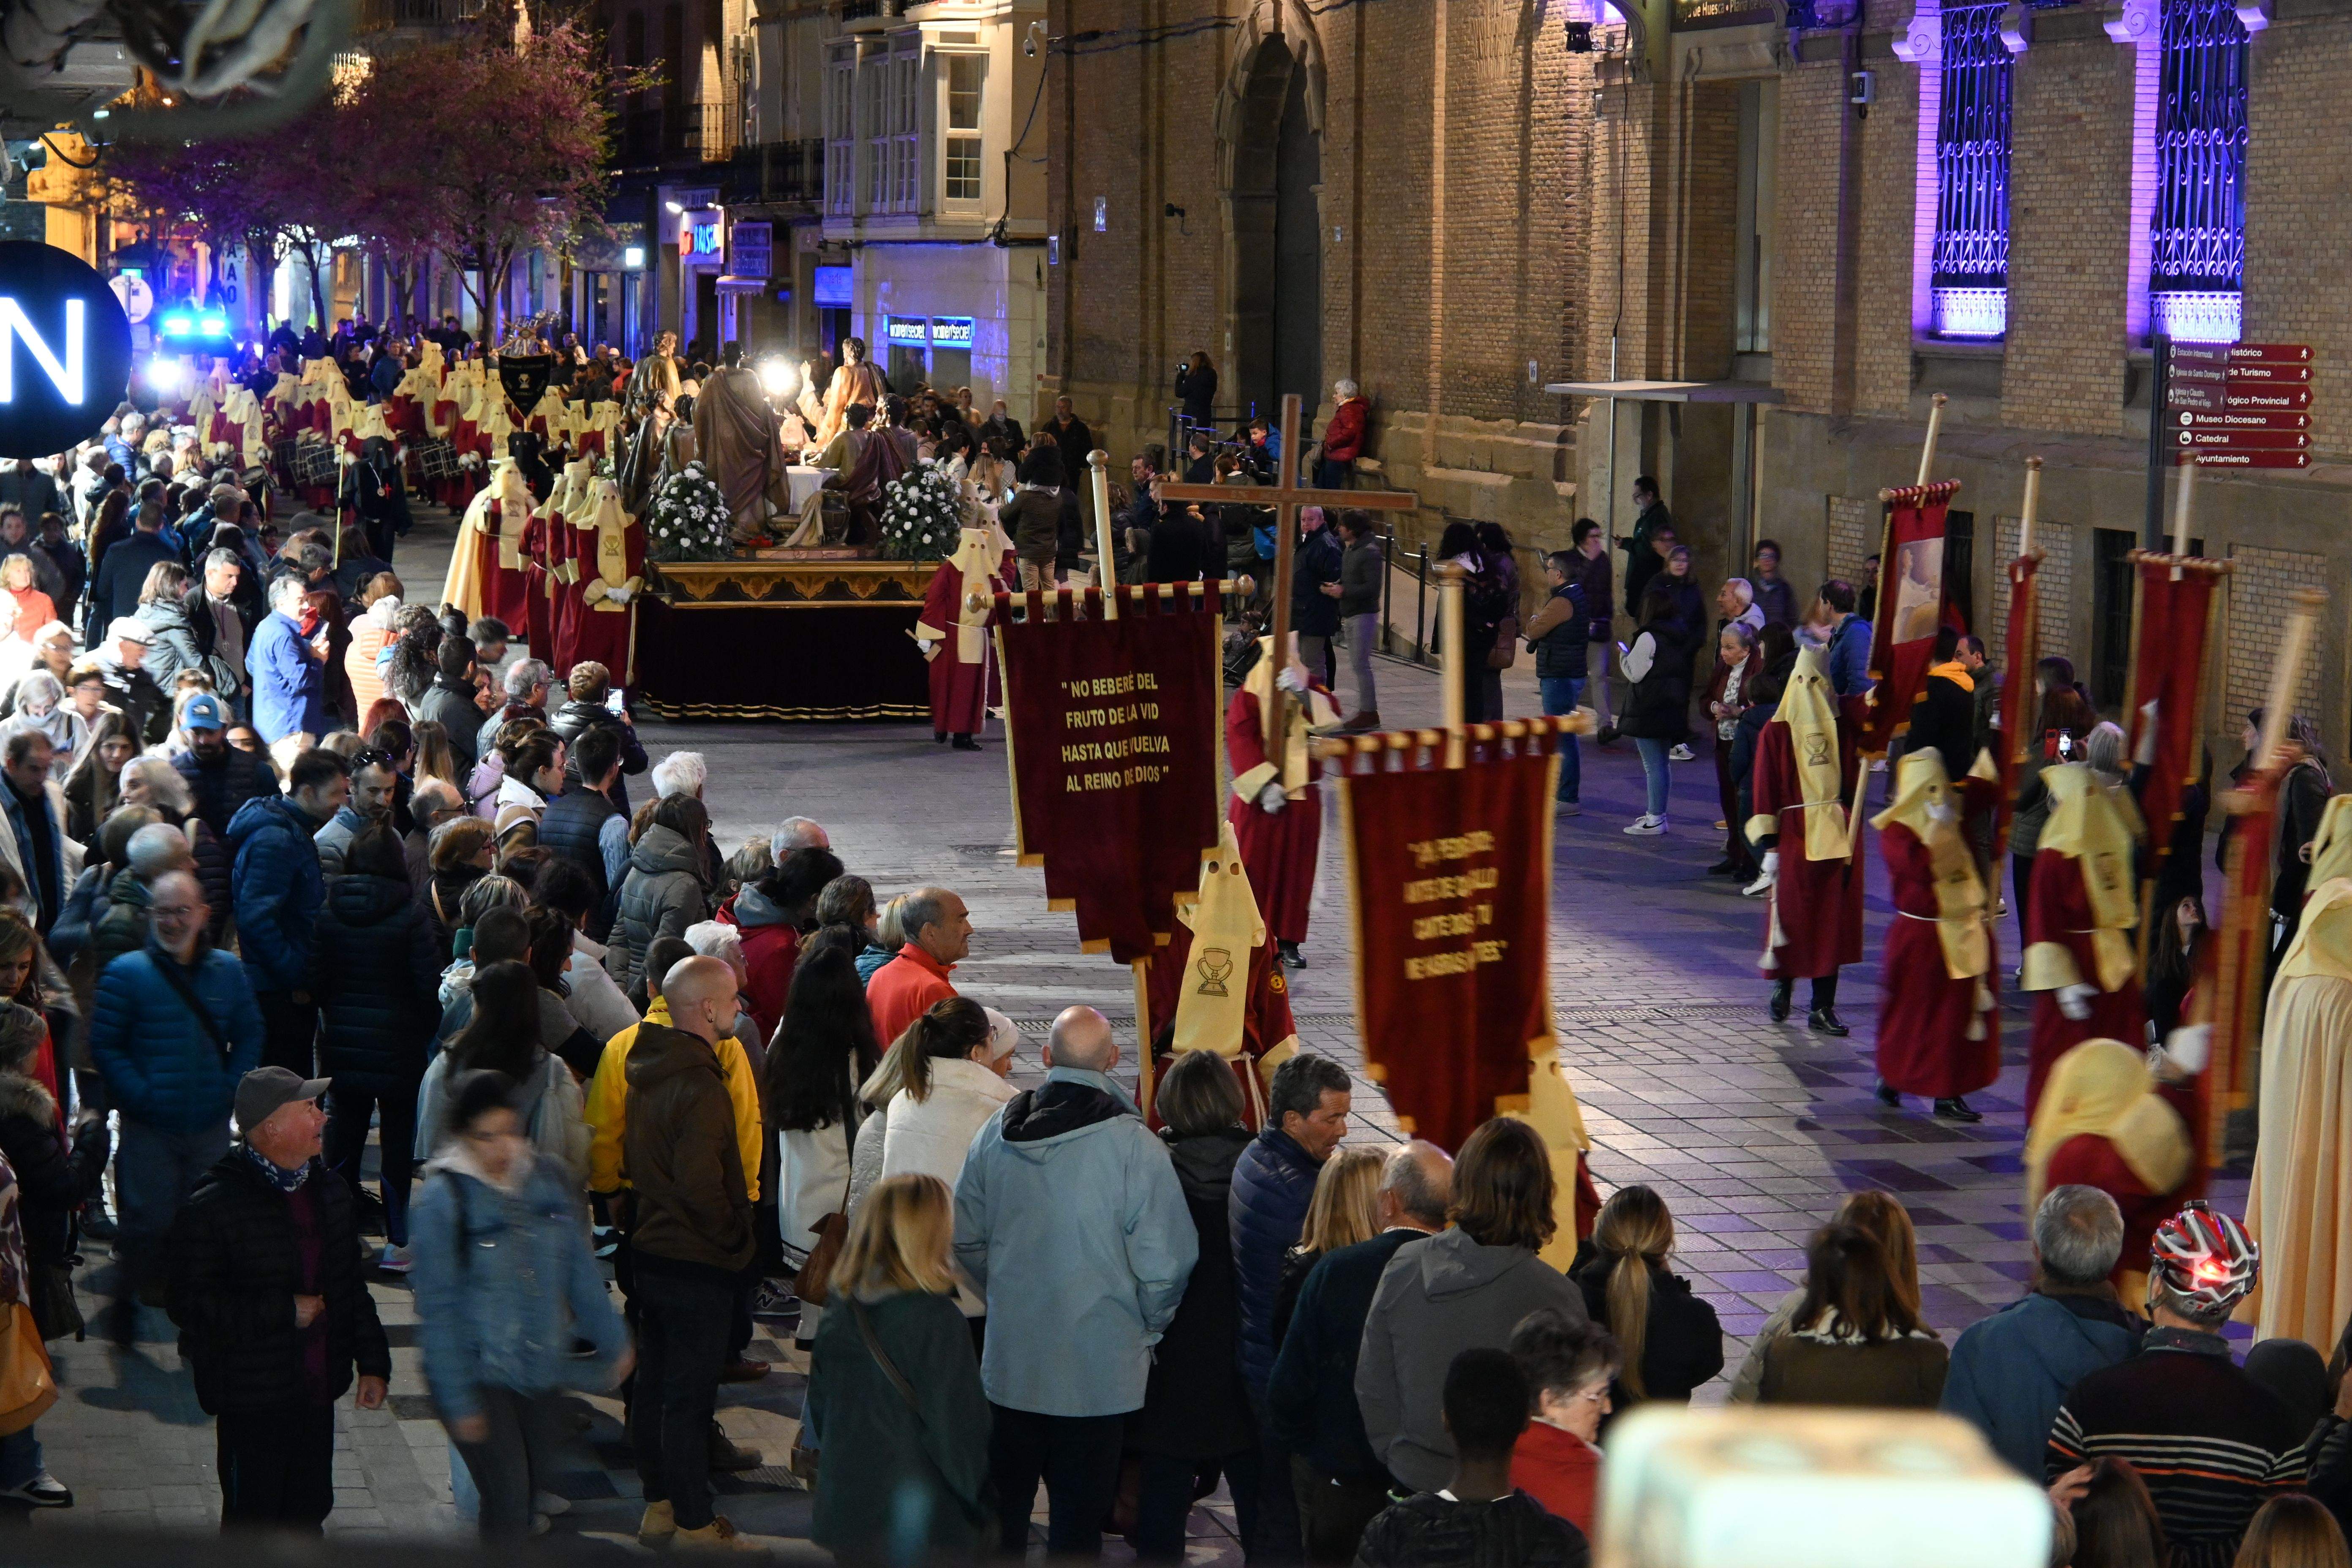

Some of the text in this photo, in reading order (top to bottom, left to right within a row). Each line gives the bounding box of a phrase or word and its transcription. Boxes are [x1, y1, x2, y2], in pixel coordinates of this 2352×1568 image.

[1702, 1, 1725, 16] Huesca
[0, 297, 83, 404] N
[2178, 348, 2213, 359] Estación Intermodal
[1530, 365, 1535, 378] 16
[2176, 368, 2187, 377] Iglesia
[2193, 369, 2203, 377] Santo
[2204, 370, 2221, 381] Domingo
[2240, 368, 2271, 377] Turismo
[2175, 387, 2186, 396] Iglesia
[2190, 388, 2205, 397] Claustro
[2175, 395, 2179, 404] de
[2187, 397, 2198, 406] Pedro
[2202, 399, 2211, 408] Viejo
[2228, 396, 2289, 406] ógico Provincial
[2196, 415, 2266, 424] Museo Diocesano
[2196, 434, 2229, 443] Catedral
[2196, 455, 2250, 464] Ayuntamiento
[1092, 670, 1134, 696] BEBERÉ
[1137, 673, 1158, 690] DEL
[1066, 702, 1159, 730] FRUTO DE LA VID
[1062, 735, 1170, 763] HASTA QUE VUELVA
[1067, 774, 1082, 792] AL
[1084, 771, 1122, 791] REINO
[1124, 768, 1134, 787] DE
[1135, 765, 1160, 783] DIOS
